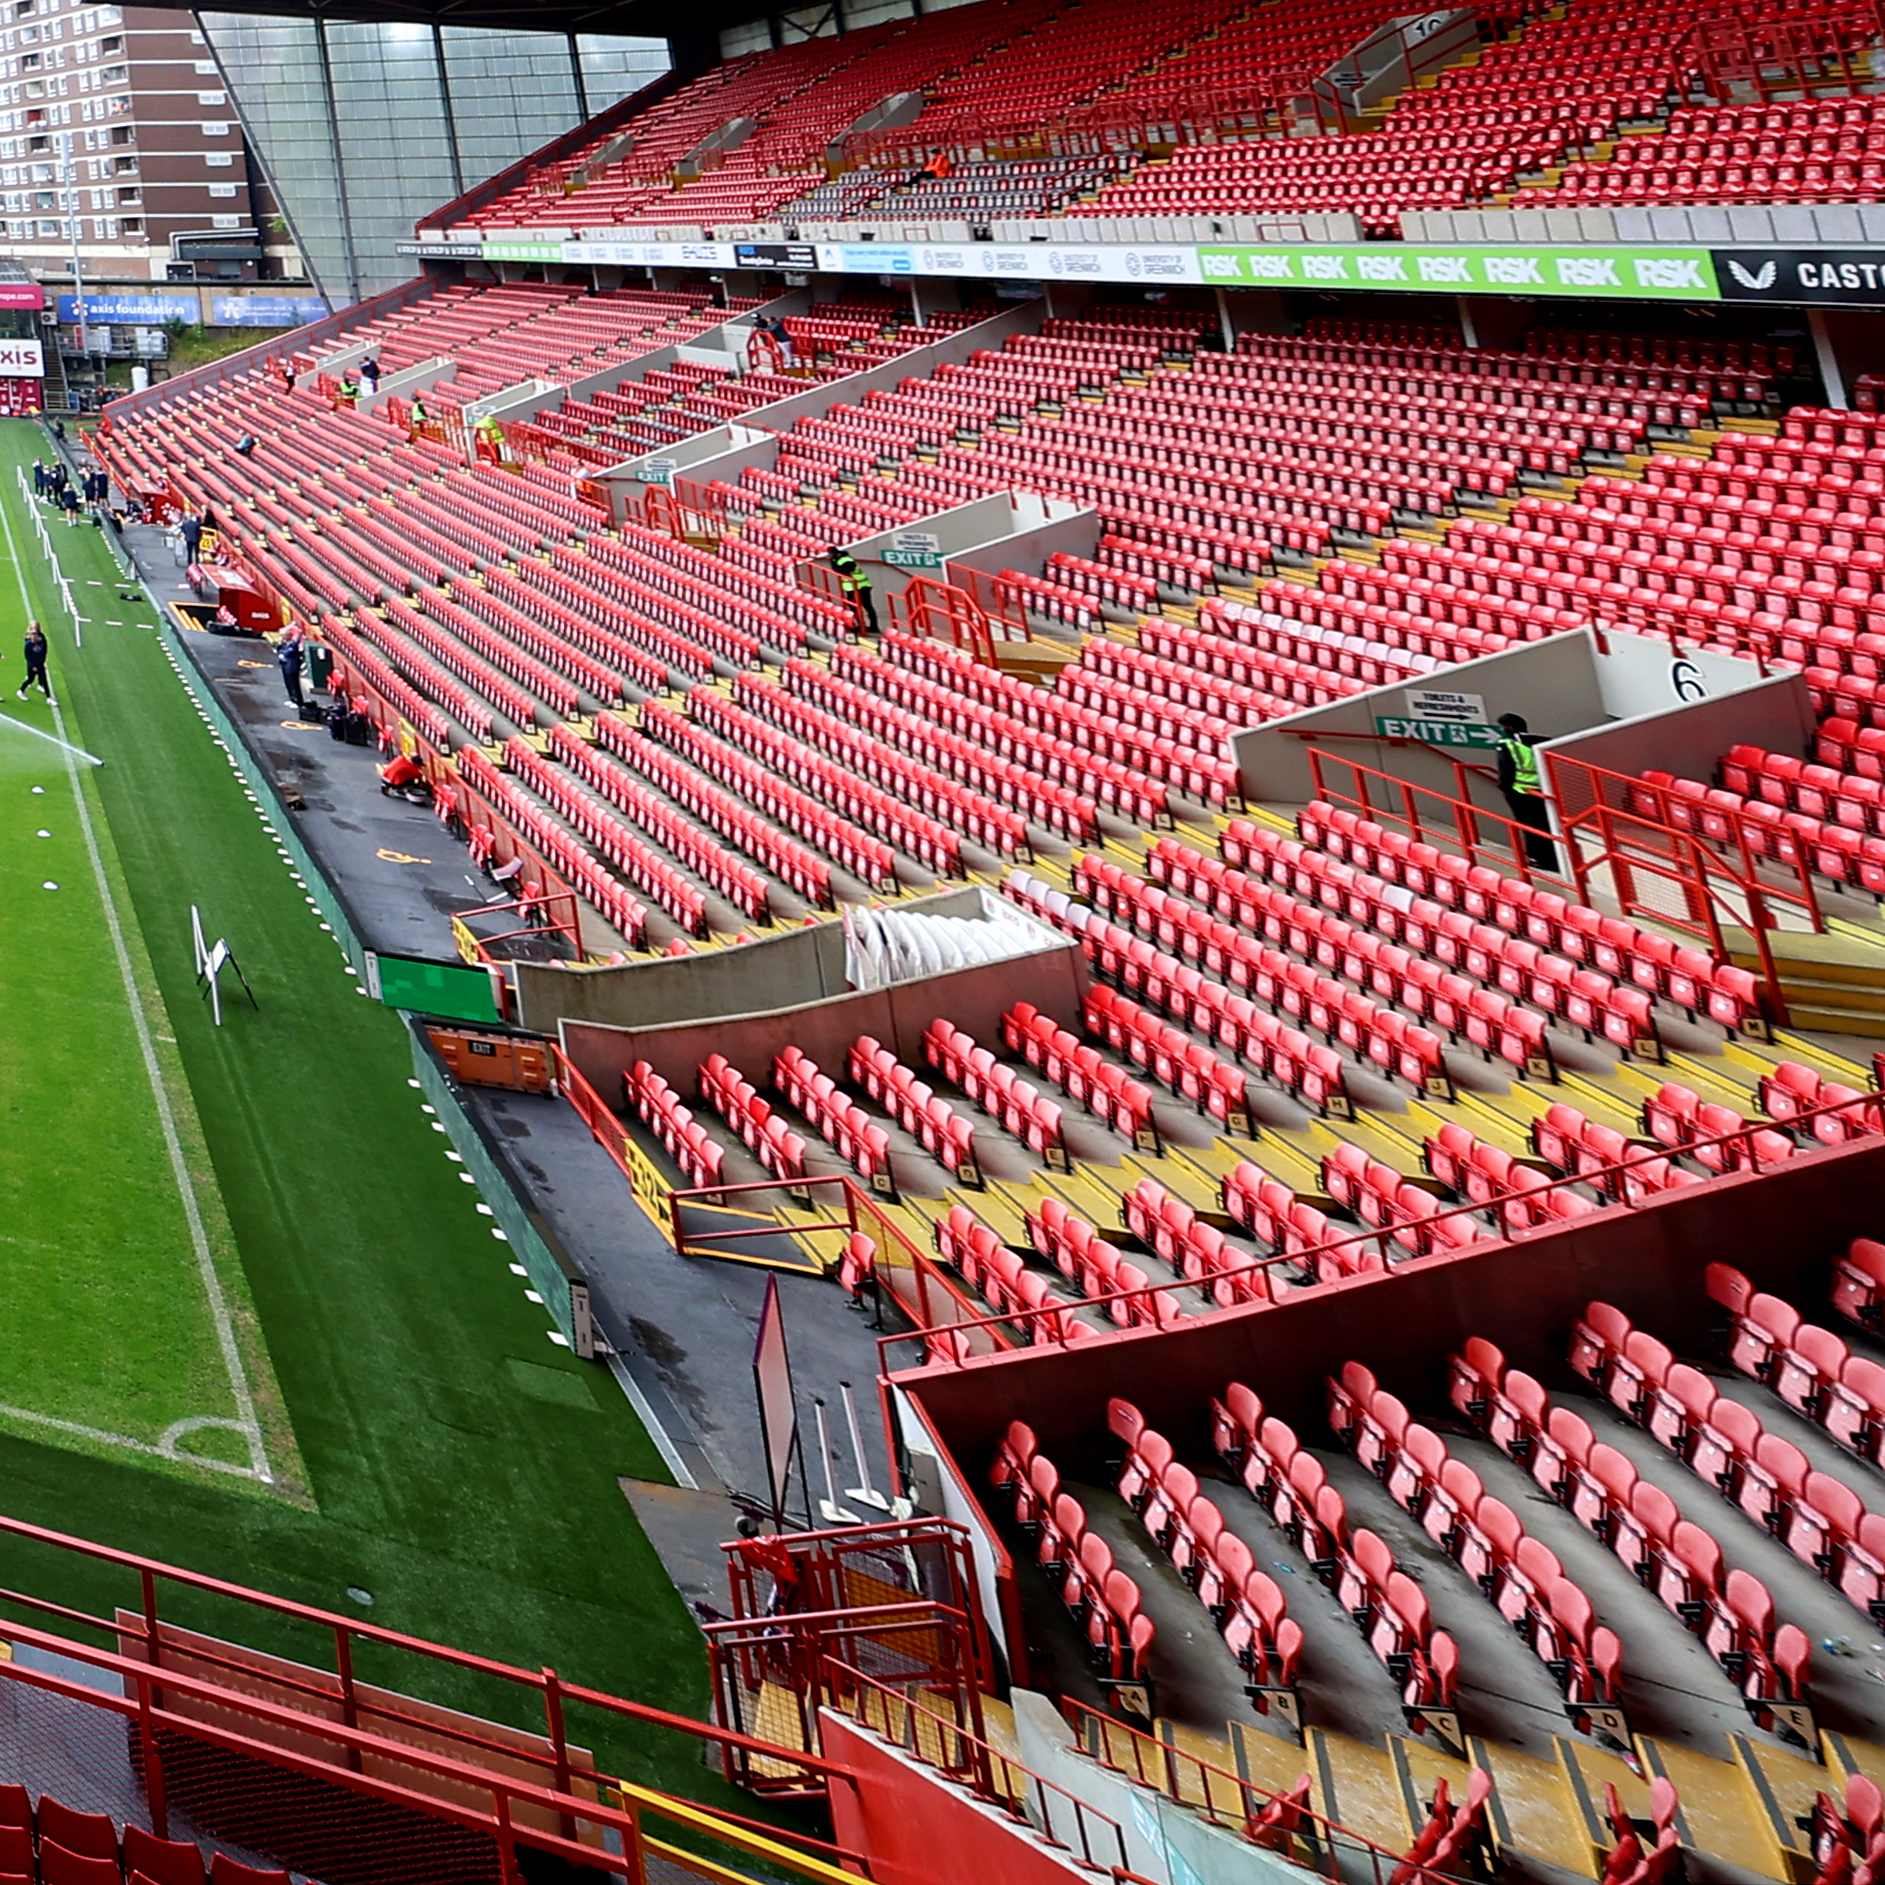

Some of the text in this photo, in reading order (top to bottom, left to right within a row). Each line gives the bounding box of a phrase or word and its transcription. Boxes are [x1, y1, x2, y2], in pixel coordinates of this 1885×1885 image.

[1202, 255, 1708, 288] RSK RSK RSK RSK RSK RSK RSK RSK
[90, 302, 185, 315] axis foundation
[637, 472, 664, 482] EXIT
[884, 551, 922, 565] EXIT
[1671, 659, 1706, 702] 6
[1422, 692, 1456, 703] TOILETS
[1413, 701, 1479, 714] REFRESHMENTS
[1384, 719, 1445, 742] EXIT
[473, 1042, 491, 1054] EXIT
[1439, 1715, 1452, 1732] C
[1603, 1711, 1619, 1728] D
